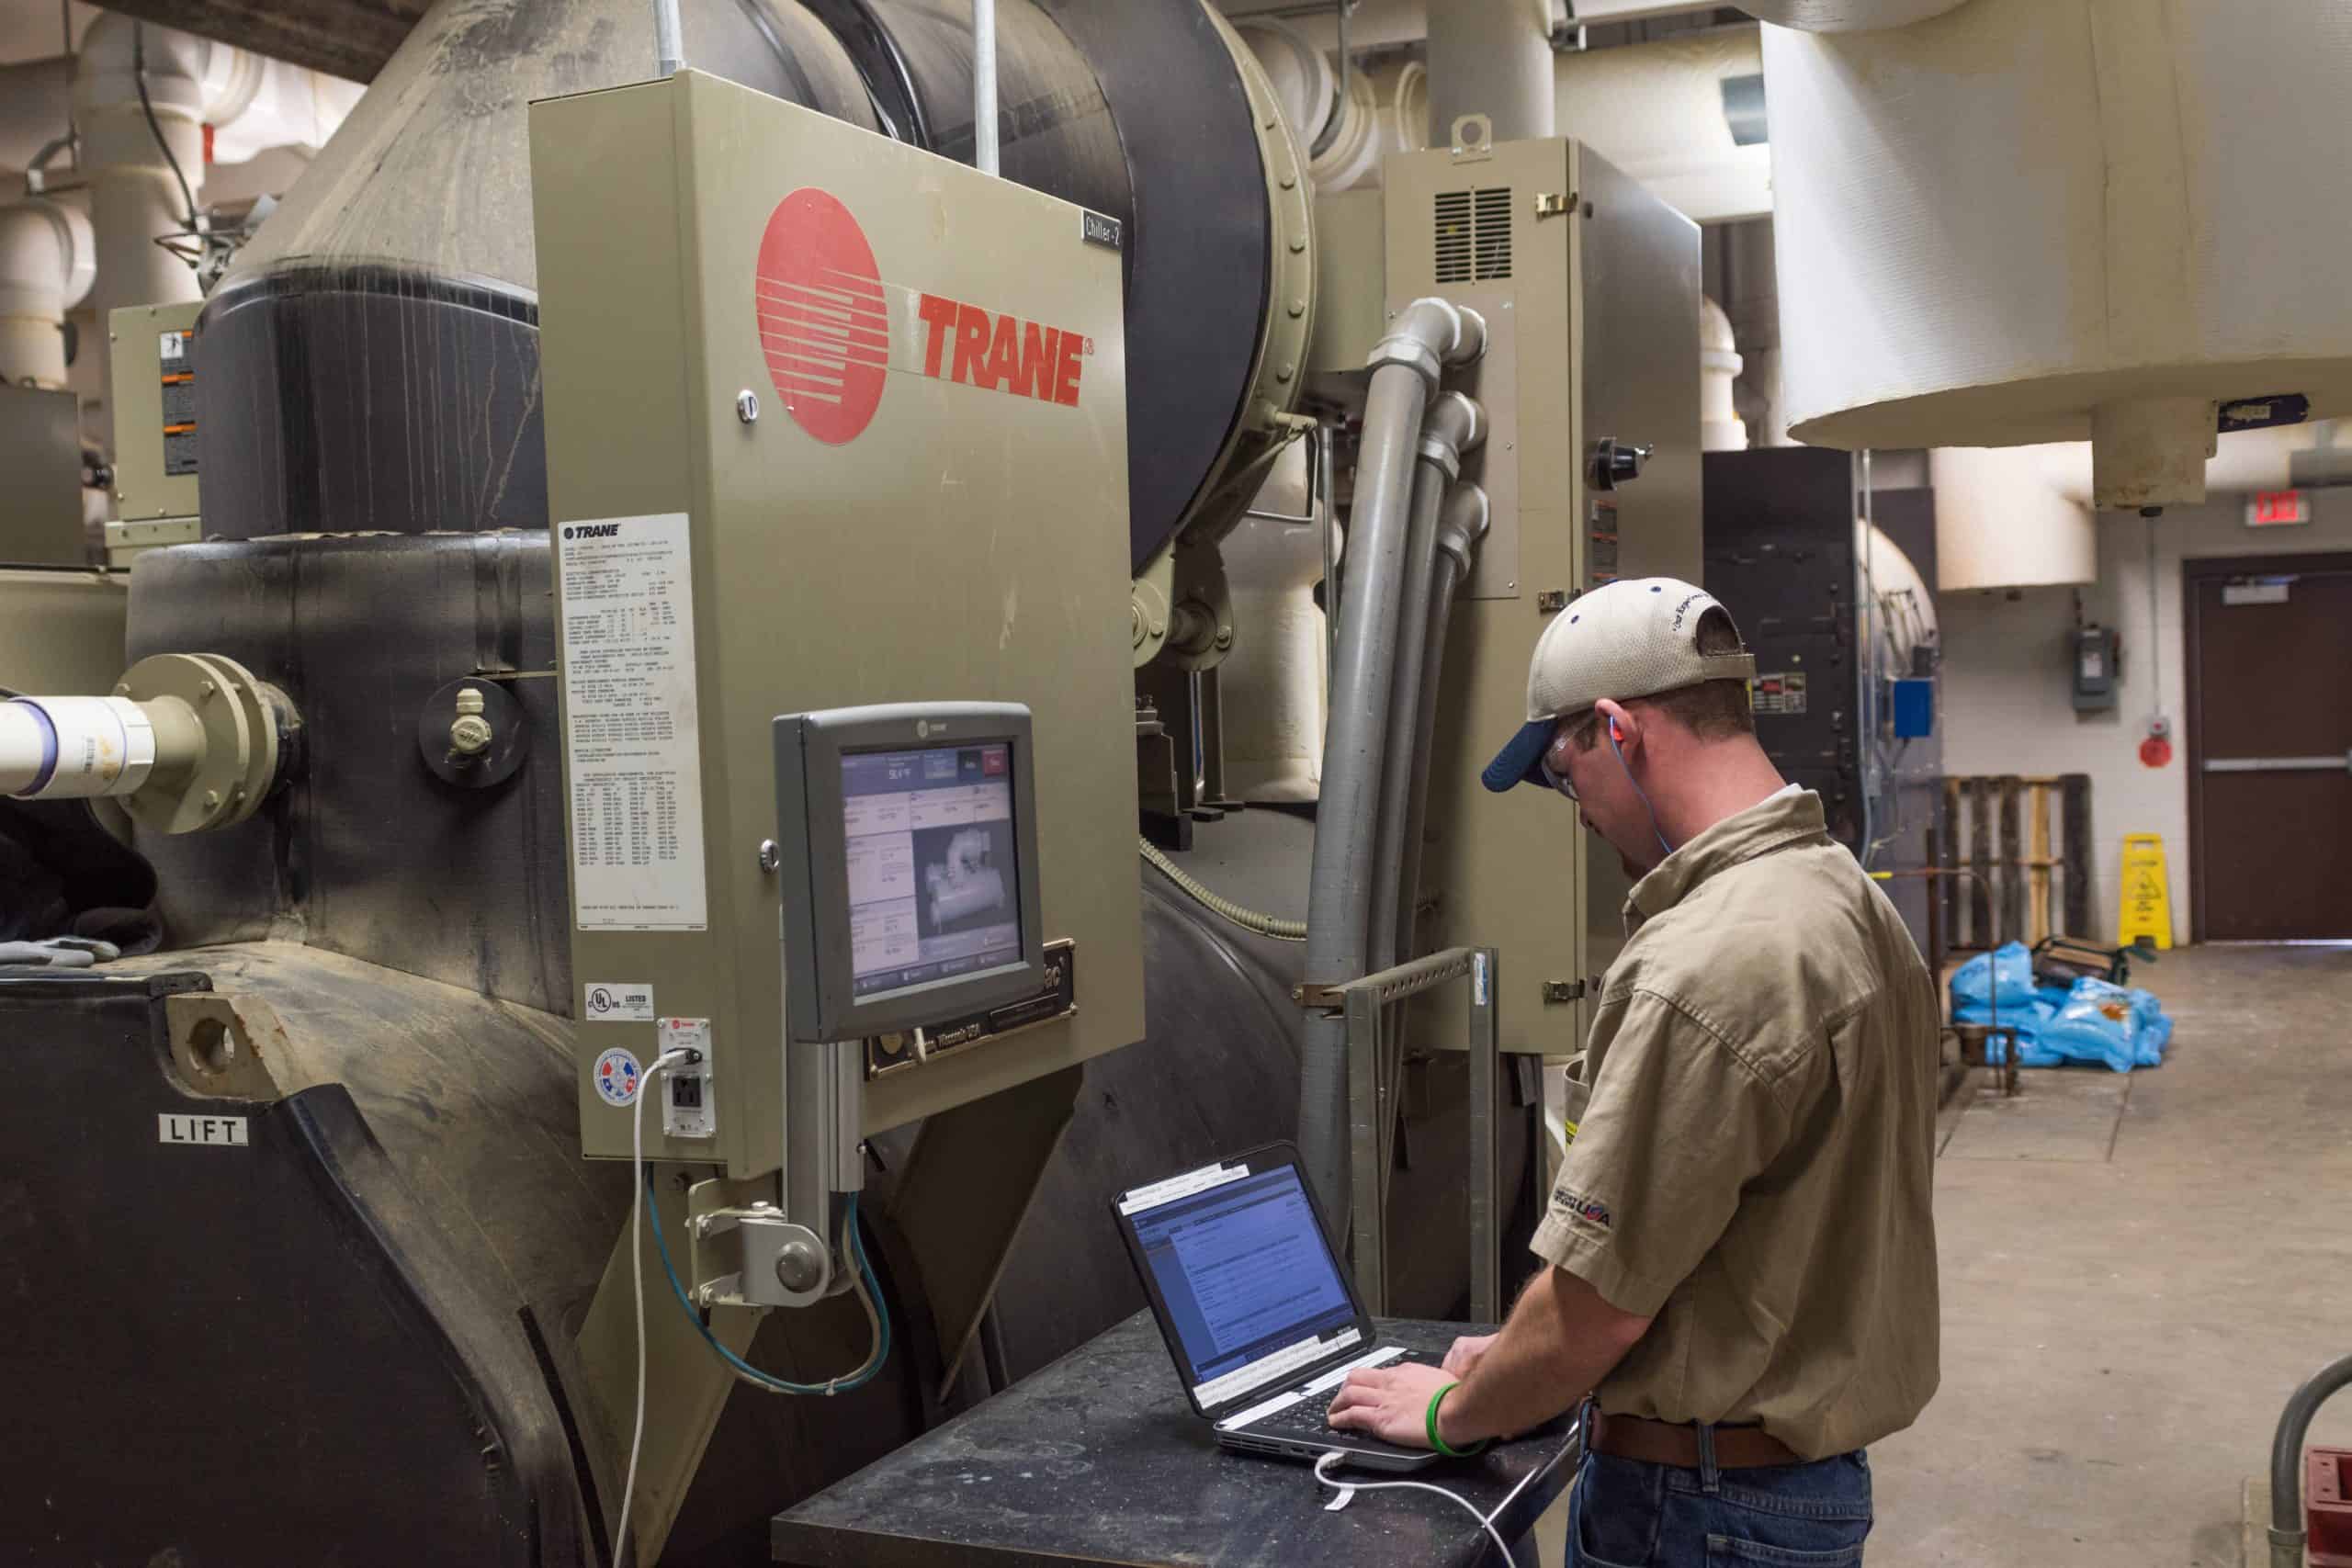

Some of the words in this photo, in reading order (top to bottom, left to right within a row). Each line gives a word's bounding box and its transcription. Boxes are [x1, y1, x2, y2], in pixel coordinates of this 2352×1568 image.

[919, 294, 1083, 407] TRANE
[575, 525, 618, 539] TRANE
[625, 994, 647, 1002] LISTED
[170, 1118, 236, 1143] LIFT
